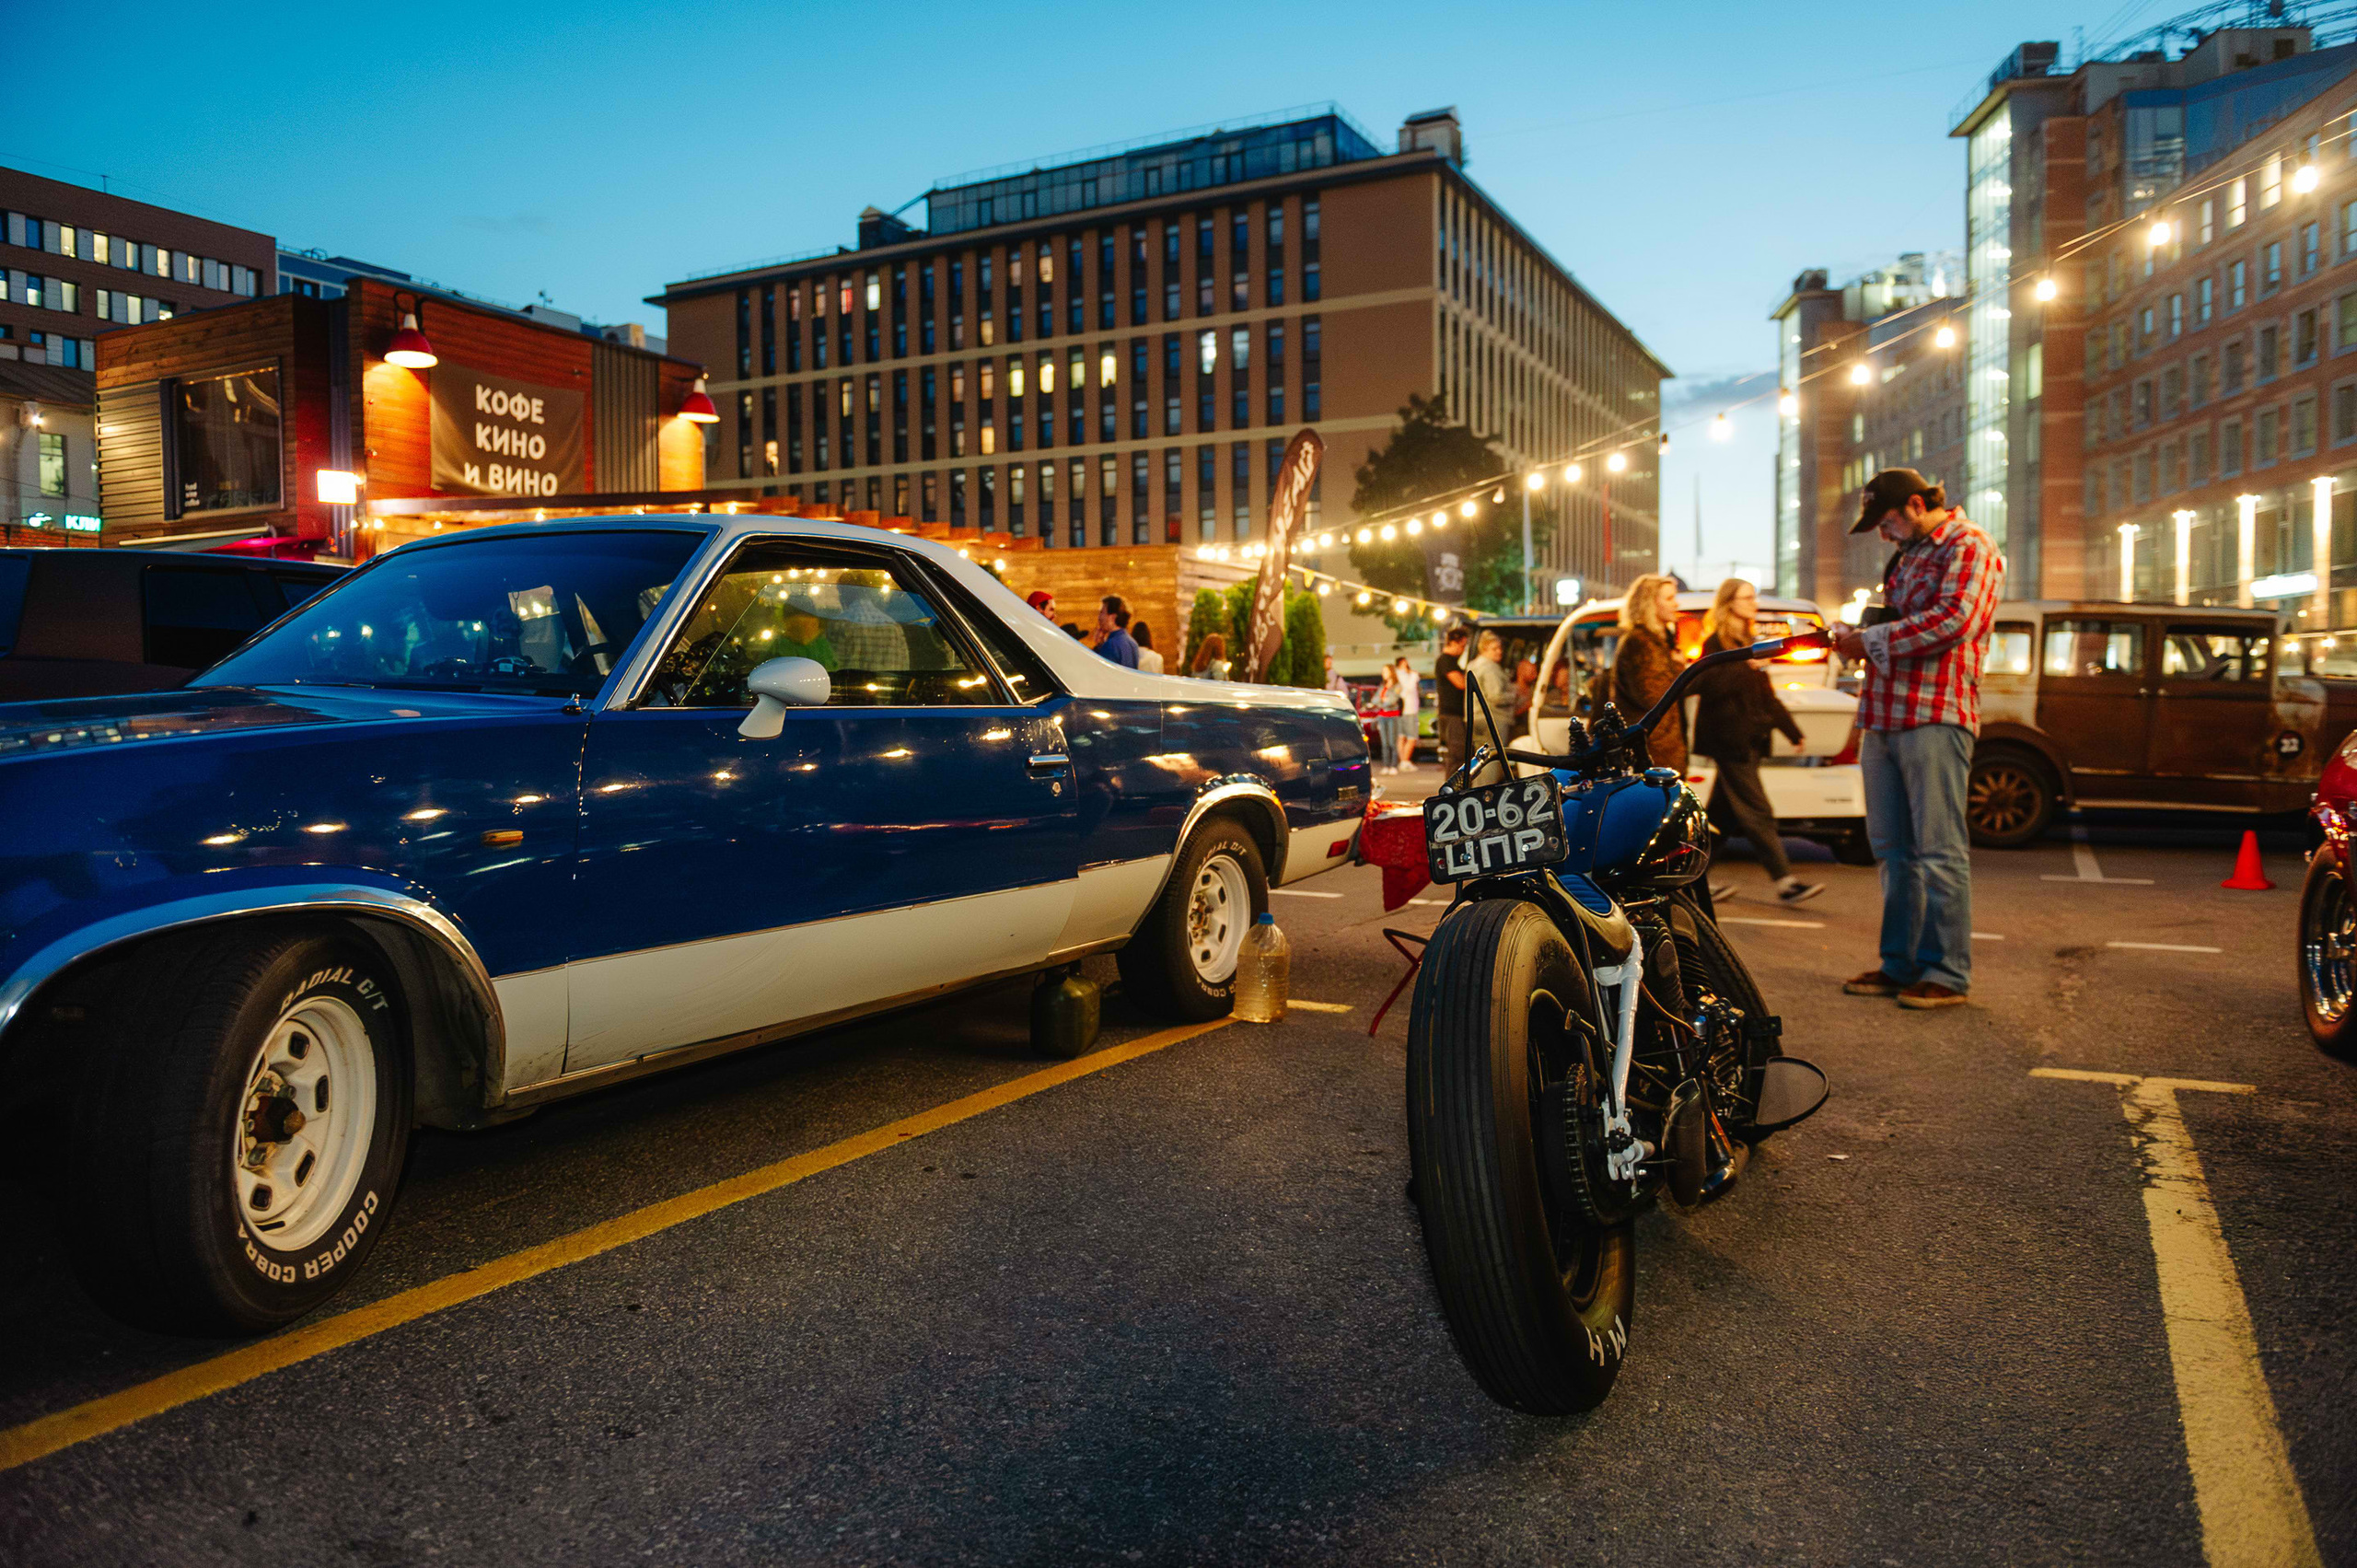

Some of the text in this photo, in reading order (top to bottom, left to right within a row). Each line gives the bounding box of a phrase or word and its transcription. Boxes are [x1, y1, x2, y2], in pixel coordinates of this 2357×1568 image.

[475, 383, 545, 424] КОФЕ
[475, 422, 546, 460] КИНО
[488, 463, 558, 497] ВИНО
[1432, 781, 1554, 843] 20-62
[1445, 828, 1545, 876] ЦПР
[279, 967, 354, 1016] RADIAL
[238, 1191, 378, 1283] COOPER COBRA
